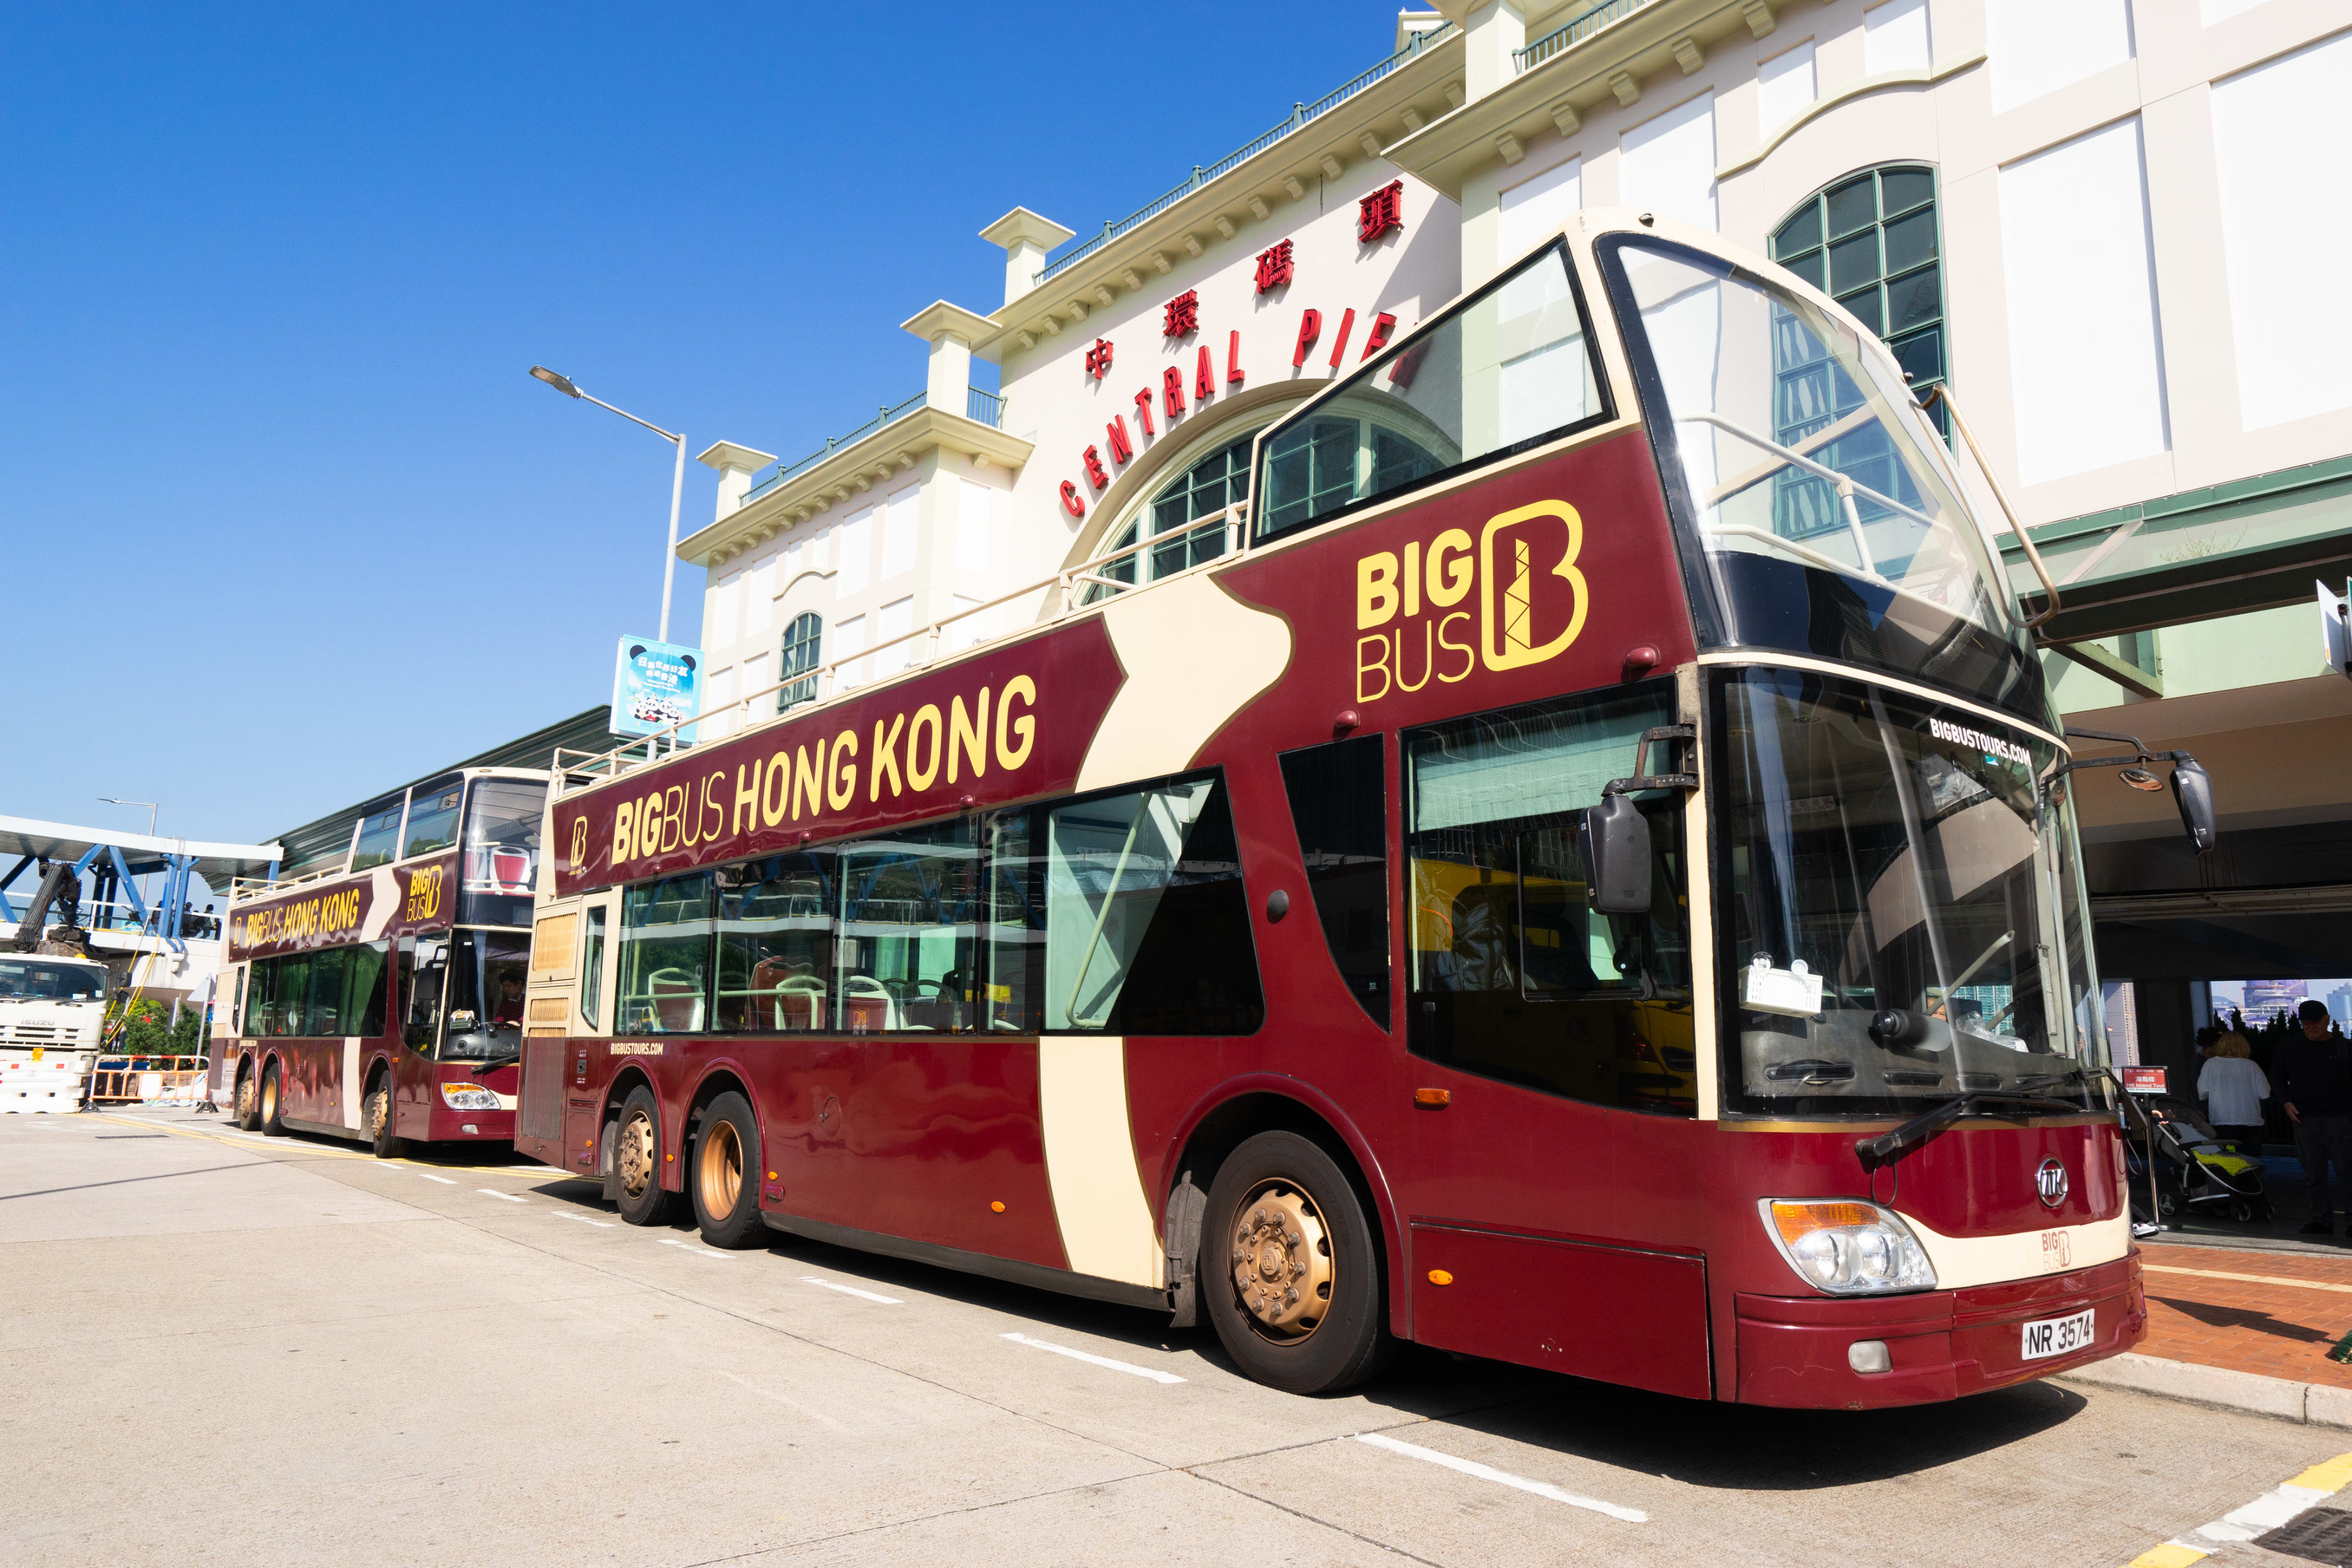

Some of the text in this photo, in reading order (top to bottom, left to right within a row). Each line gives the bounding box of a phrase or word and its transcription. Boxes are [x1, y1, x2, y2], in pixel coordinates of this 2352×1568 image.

[1085, 180, 1404, 381] 中環碼頭
[1060, 330, 1245, 518] CENTRAL
[1357, 529, 1473, 630] BIG
[1357, 612, 1474, 703] BUS
[733, 730, 858, 835] HONG
[870, 675, 1036, 802] KONG
[1930, 718, 2032, 767] BIGBUSTOURS.COM
[410, 867, 429, 896] BIG
[283, 898, 320, 939] HONG
[321, 888, 360, 933] KONG
[407, 895, 425, 922] BUS
[611, 1043, 663, 1055] BIGBUSTOURS.COM
[2041, 1231, 2058, 1251] BIG
[2043, 1251, 2060, 1271] BUS
[2029, 1314, 2090, 1354] NR 3574
